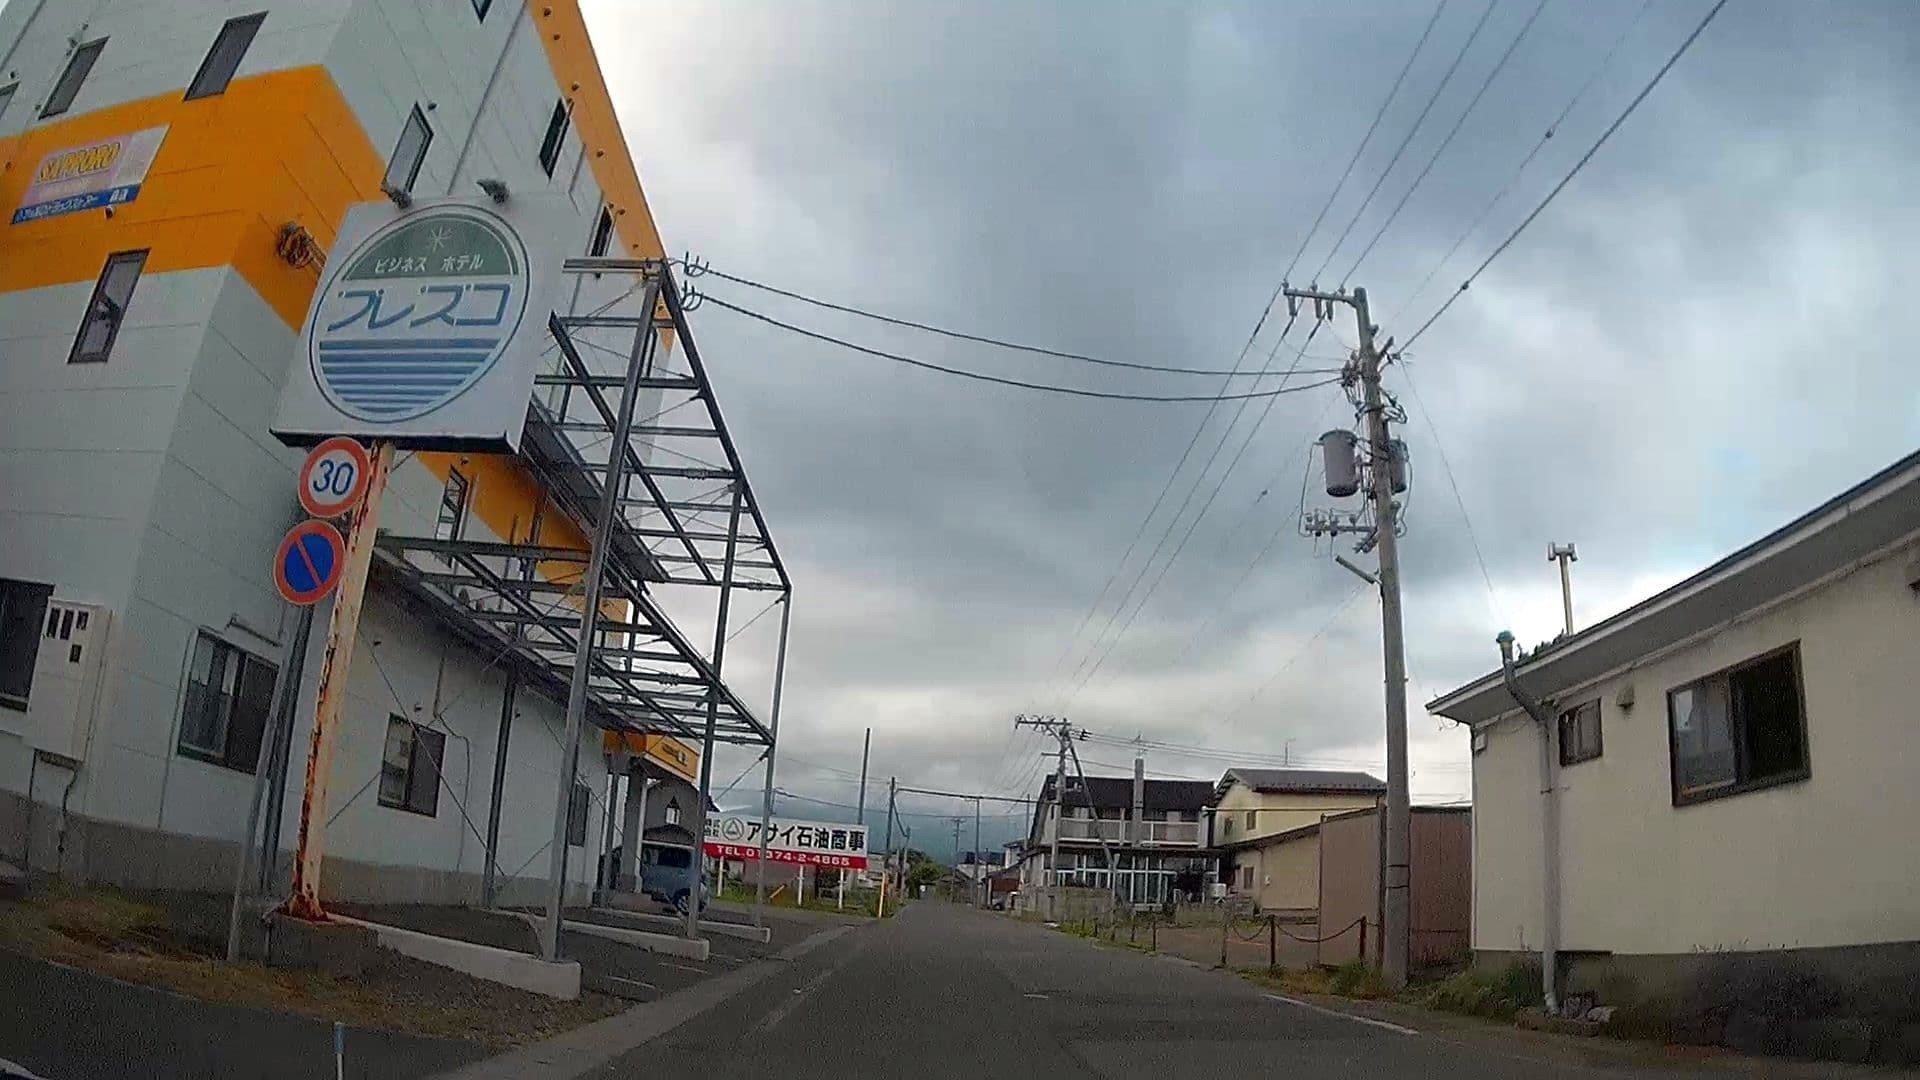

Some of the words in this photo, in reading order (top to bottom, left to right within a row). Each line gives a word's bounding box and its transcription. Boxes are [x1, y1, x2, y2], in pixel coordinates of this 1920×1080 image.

[375, 256, 428, 274] ビジネス
[441, 253, 484, 272] ホテル
[313, 459, 354, 496] 30
